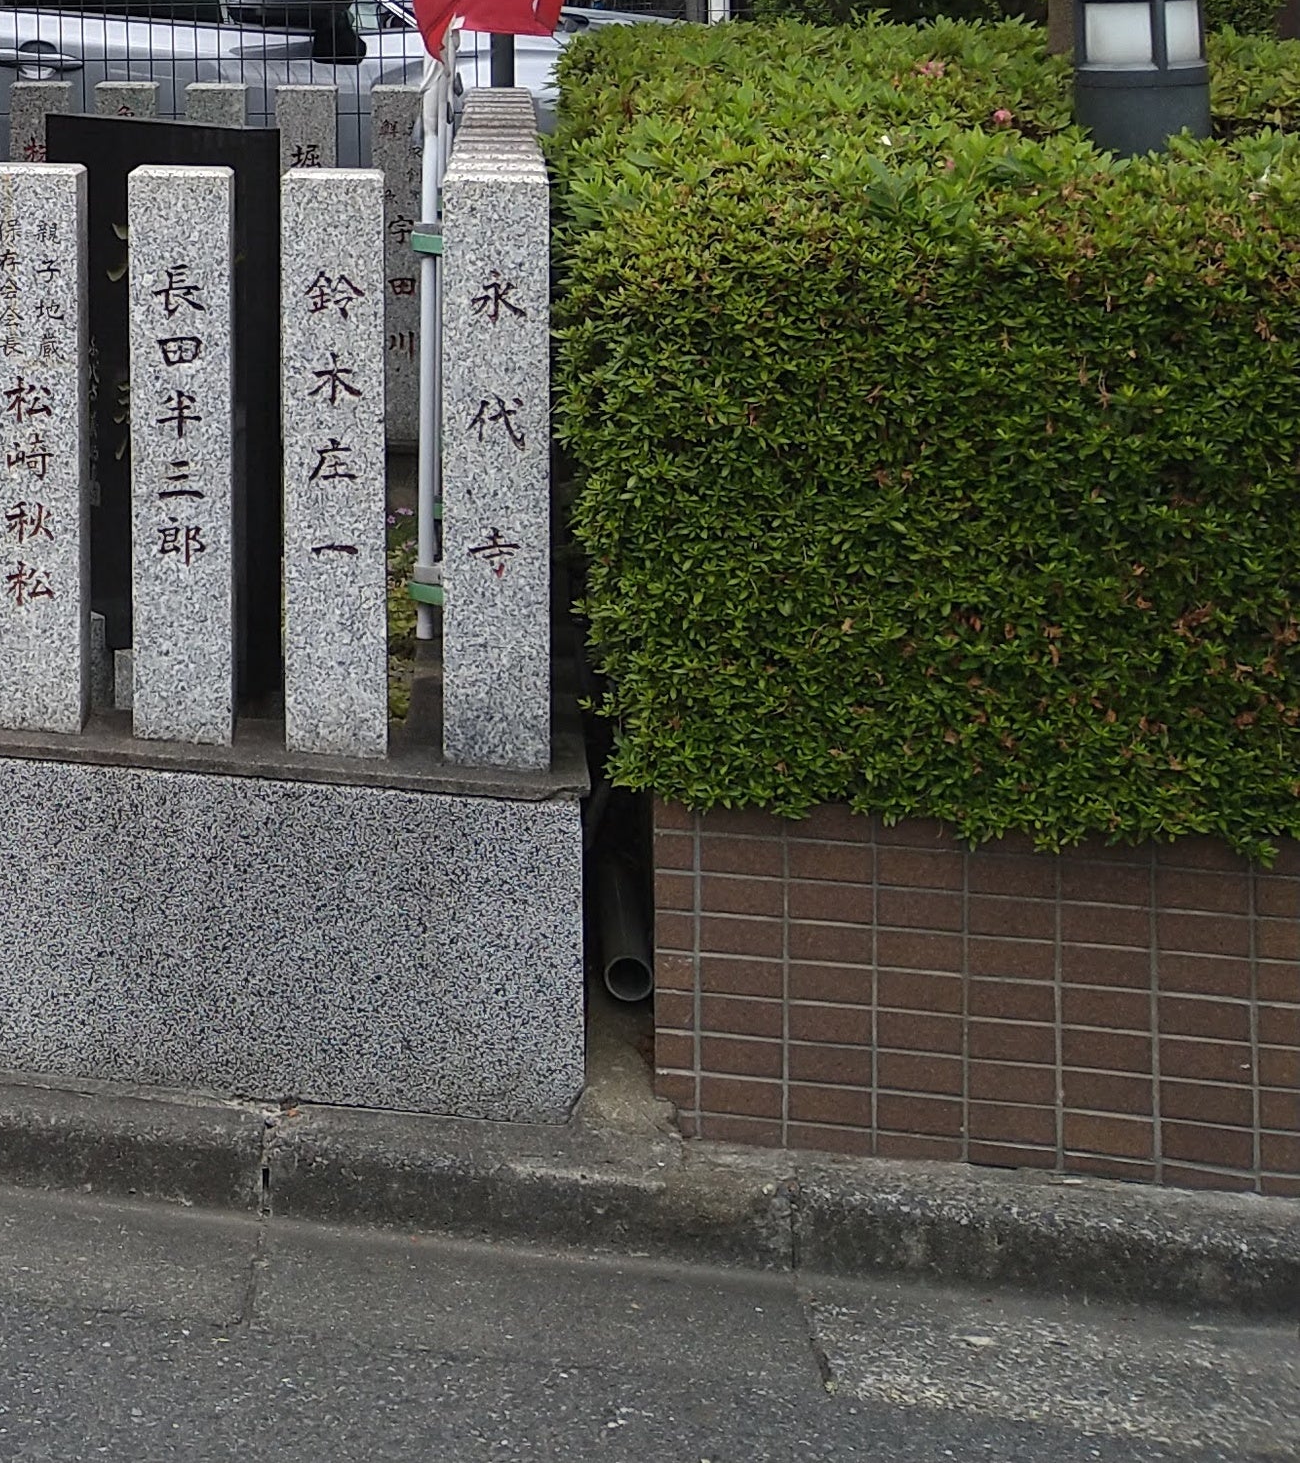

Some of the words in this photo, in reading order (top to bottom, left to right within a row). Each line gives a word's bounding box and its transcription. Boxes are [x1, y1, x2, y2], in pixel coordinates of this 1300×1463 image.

[152, 264, 208, 568] 長田半三郎
[301, 270, 367, 558] 鈴木庄一
[387, 214, 416, 360] 宇田川
[464, 268, 528, 582] 永代寺
